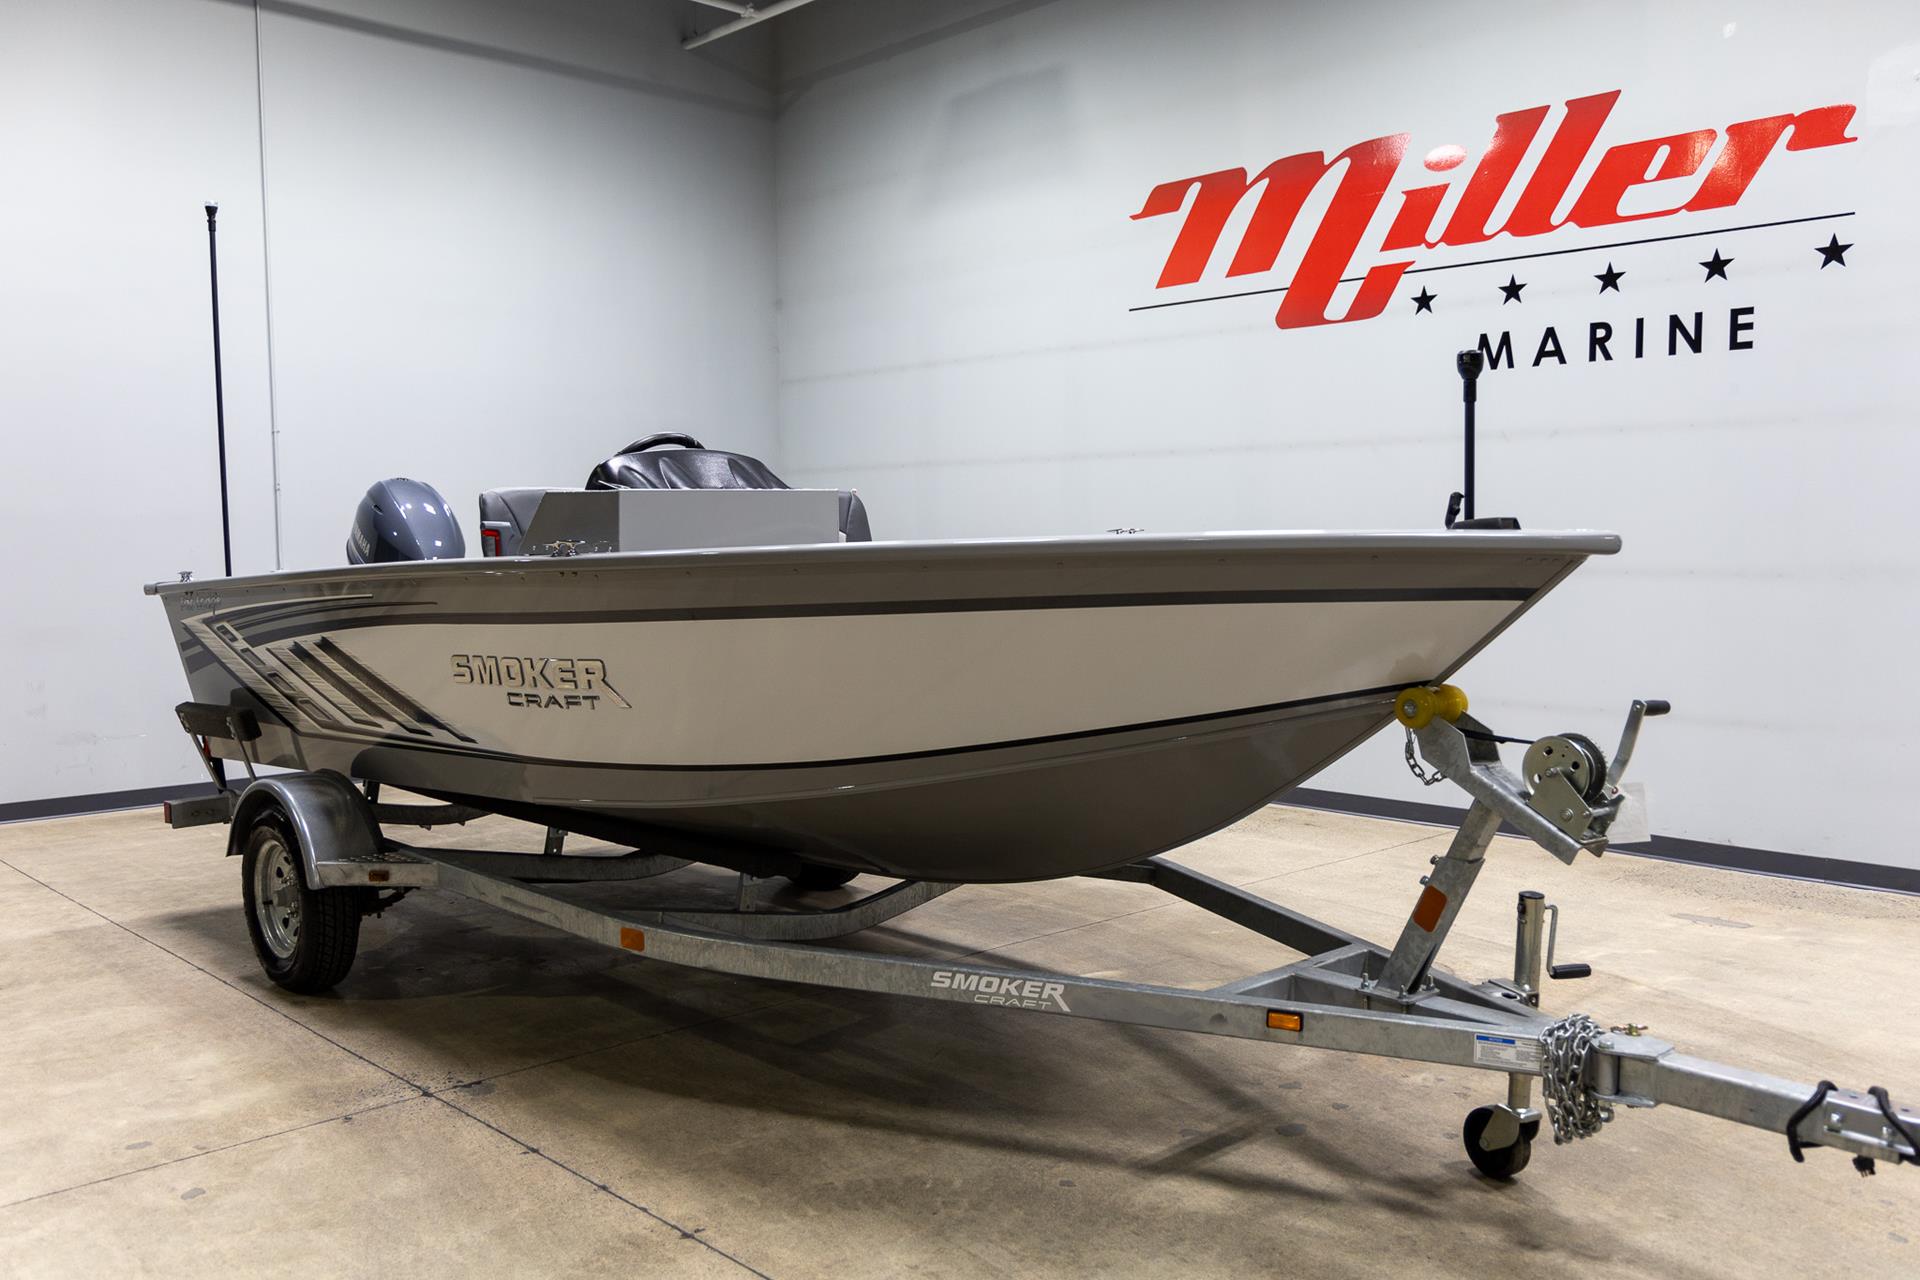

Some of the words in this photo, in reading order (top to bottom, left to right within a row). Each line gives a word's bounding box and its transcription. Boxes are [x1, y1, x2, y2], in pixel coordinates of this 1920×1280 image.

[1129, 89, 1859, 330] Miller
[1477, 306, 1755, 370] MARINE
[451, 654, 633, 709] SMOKER
[506, 691, 601, 711] CRAFT
[930, 970, 1072, 1013] SMOKER
[974, 994, 1052, 1010] CRAFT
